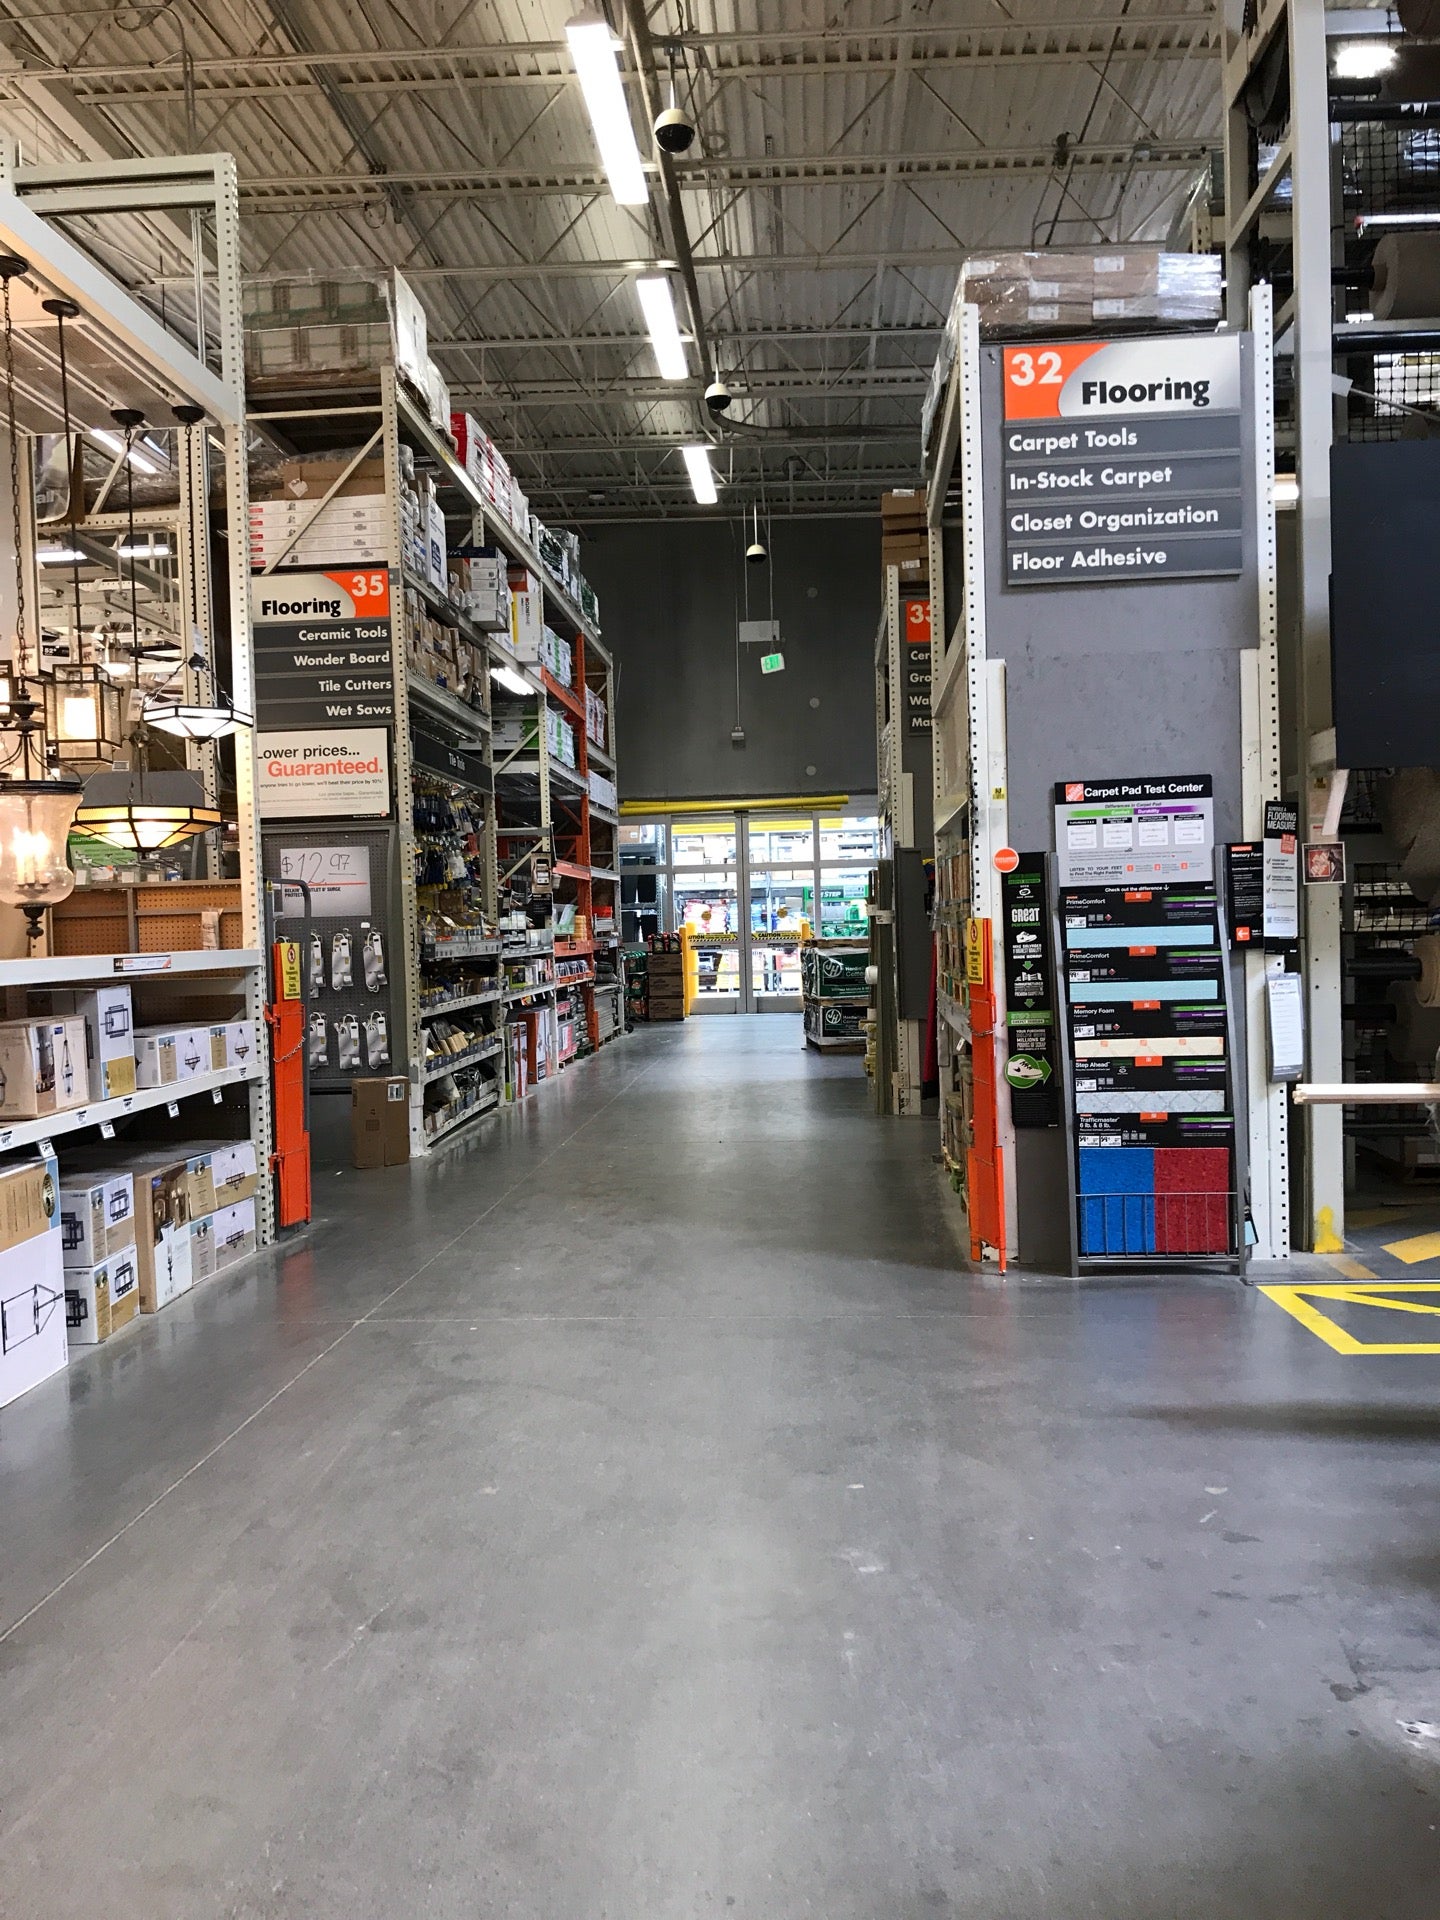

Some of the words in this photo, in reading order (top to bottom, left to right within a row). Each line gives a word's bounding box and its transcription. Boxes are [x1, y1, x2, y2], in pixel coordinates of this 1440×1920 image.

[1010, 351, 1063, 386] 32
[1082, 377, 1210, 407] Flooring
[1009, 433, 1078, 454] Carpet
[1085, 427, 1138, 447] Tools
[1010, 468, 1094, 490] In-Stock
[1101, 466, 1172, 488] Carpet
[1010, 512, 1073, 532] Closet
[1079, 505, 1219, 532] Organization
[1012, 551, 1064, 571] Floor
[1071, 547, 1167, 568] Adhesive
[352, 574, 384, 597] 35
[262, 598, 341, 617] Flooring
[299, 627, 351, 641] Ceramic
[355, 625, 388, 638] Tools
[293, 653, 345, 667] Wonder
[350, 650, 390, 664] Board
[910, 650, 931, 660] Cer
[318, 679, 341, 692] Tile
[345, 680, 392, 690] Cutters
[910, 672, 931, 683] Gro
[909, 695, 931, 706] Wa
[326, 705, 352, 716] Wet
[356, 704, 392, 715] Saws
[911, 717, 932, 727] Ma
[268, 757, 384, 777] Guaranteed.
[1084, 786, 1119, 798] Carpet
[1121, 784, 1142, 796] Pad
[1144, 783, 1166, 794] Test
[1168, 782, 1204, 793] Center
[1267, 811, 1297, 821] FLOORING
[1266, 820, 1296, 830] MEASURE
